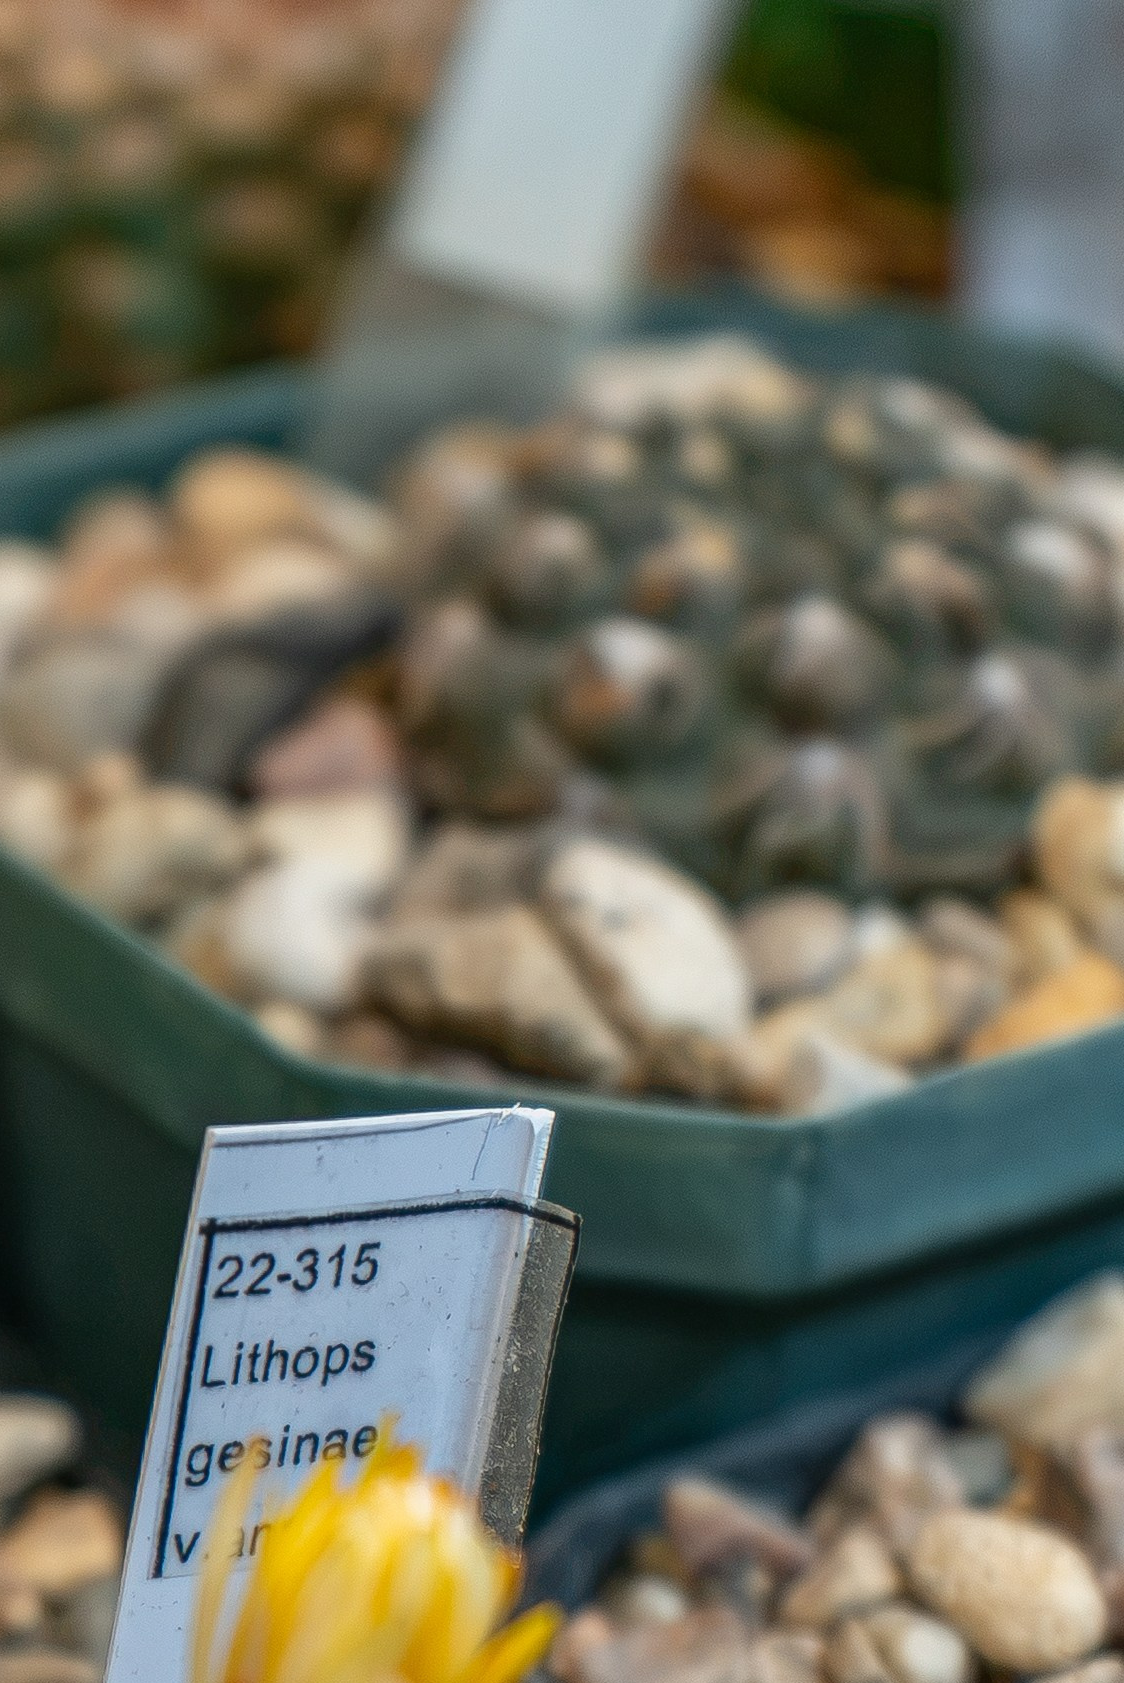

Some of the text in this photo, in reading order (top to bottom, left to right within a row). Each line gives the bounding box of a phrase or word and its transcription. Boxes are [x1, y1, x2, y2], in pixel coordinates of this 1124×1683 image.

[212, 1242, 382, 1299] 22-315
[199, 1338, 376, 1388] Lithops
[184, 1424, 377, 1487] gesinae
